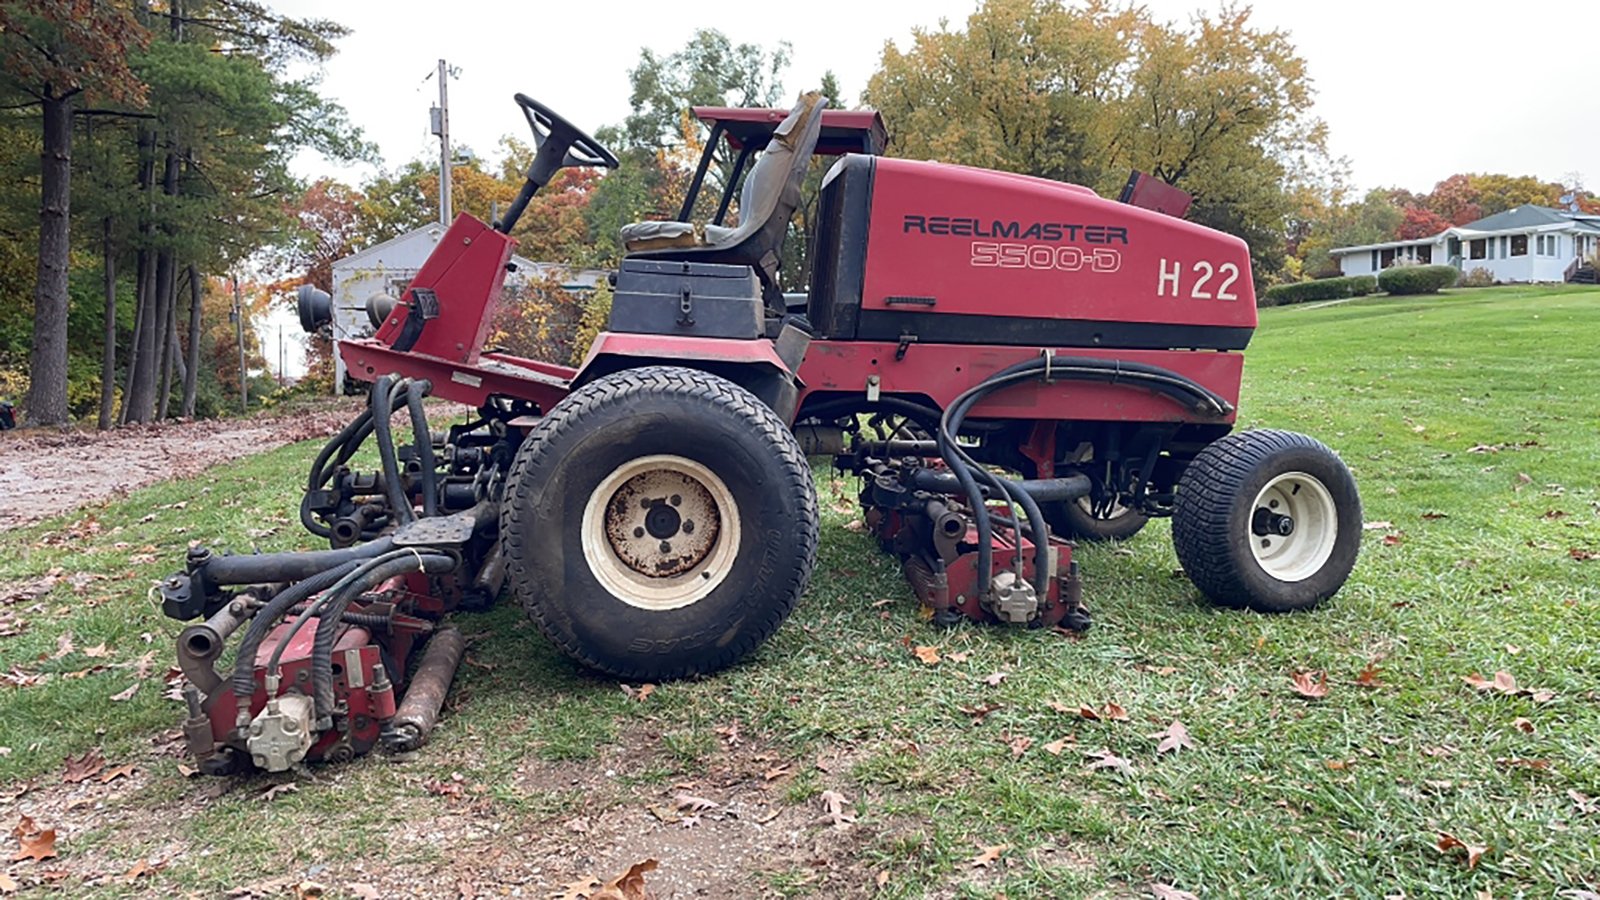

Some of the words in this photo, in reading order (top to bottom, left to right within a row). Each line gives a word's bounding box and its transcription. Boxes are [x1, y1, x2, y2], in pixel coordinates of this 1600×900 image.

[903, 215, 1128, 244] REELMASTER
[971, 242, 1121, 272] 5500-D
[1157, 258, 1180, 297] H
[1191, 261, 1239, 300] 22
